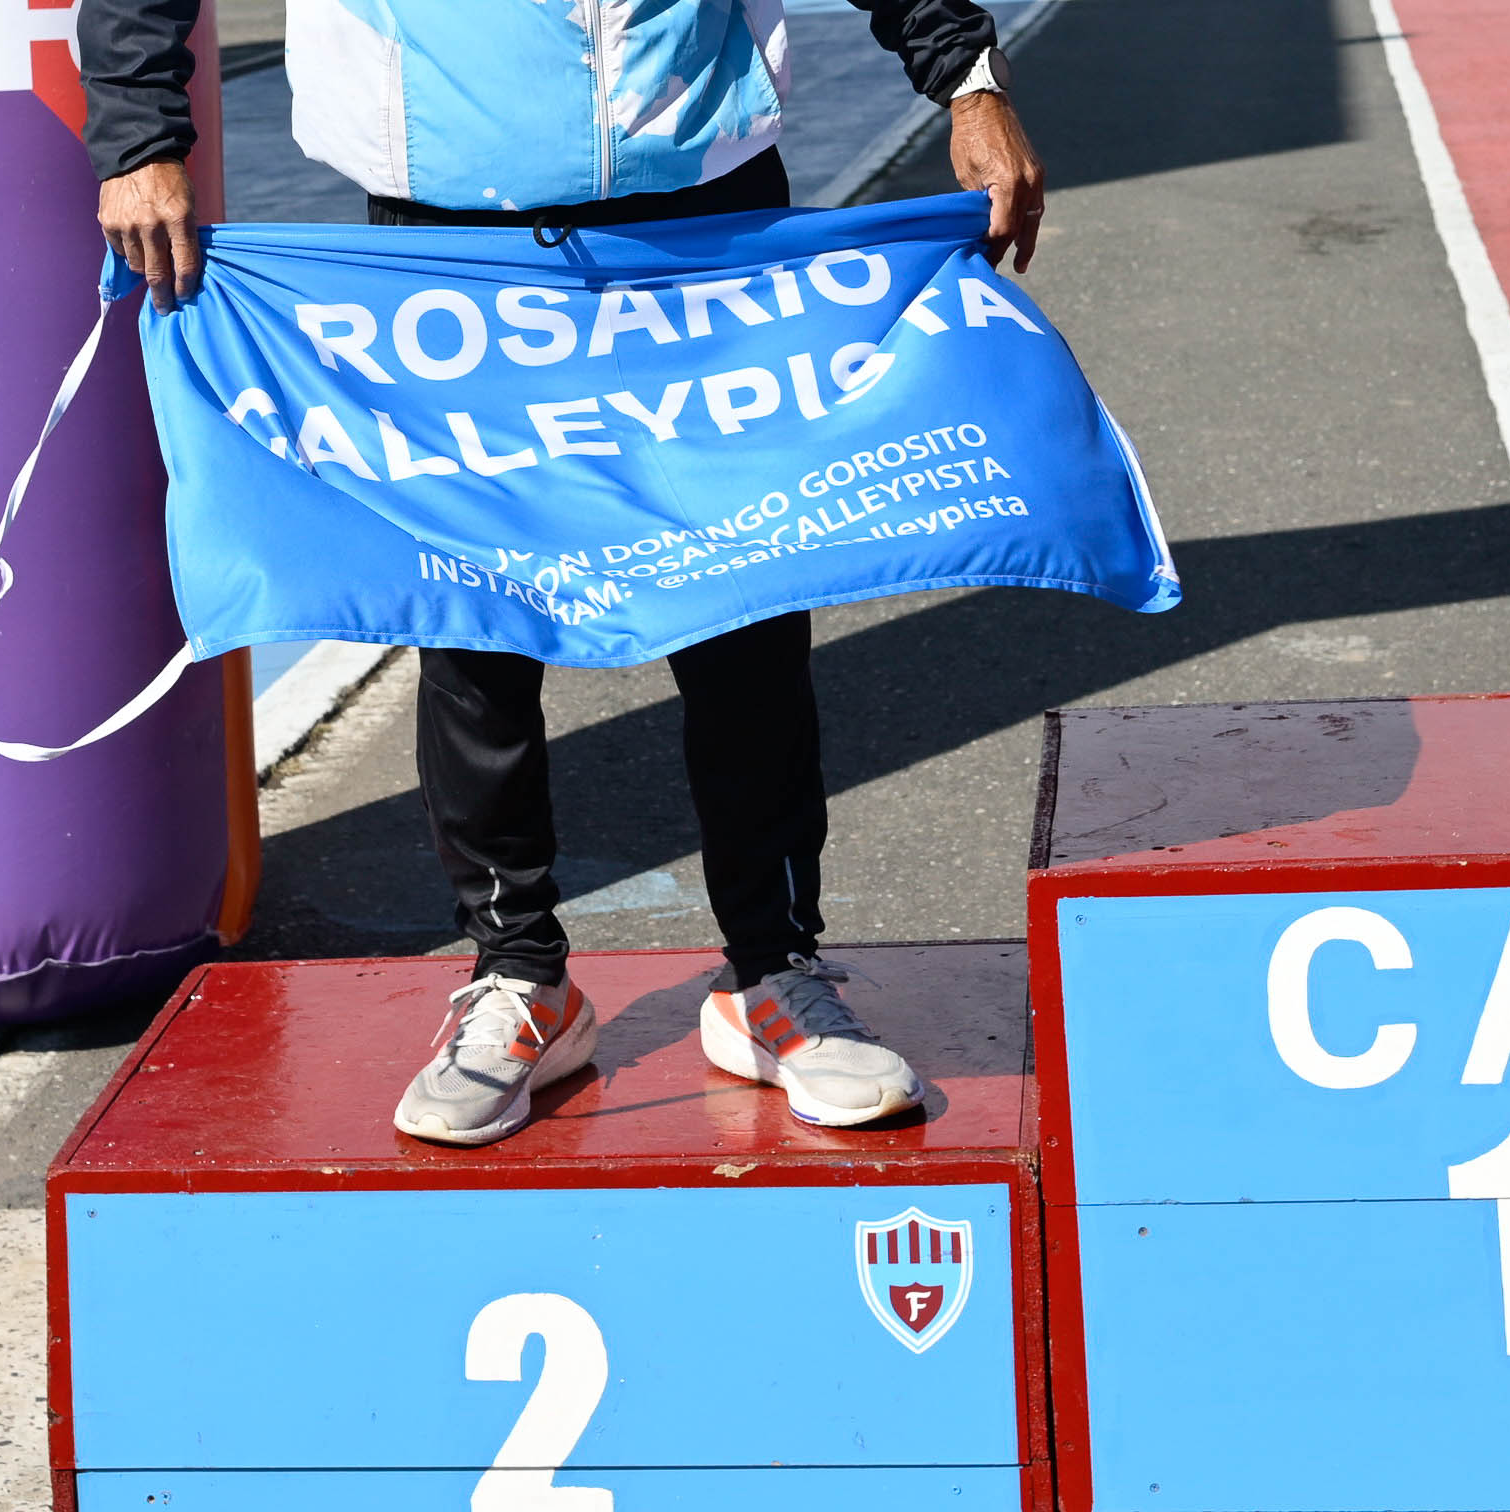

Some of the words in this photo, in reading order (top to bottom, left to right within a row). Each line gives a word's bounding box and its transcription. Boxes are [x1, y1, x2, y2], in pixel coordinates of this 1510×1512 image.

[294, 249, 892, 385] ROSARIO
[601, 491, 790, 564] DOMINGO
[799, 423, 987, 498] GOROSITO
[418, 552, 633, 626] INSTAGRAM:
[465, 1293, 614, 1512] 2
